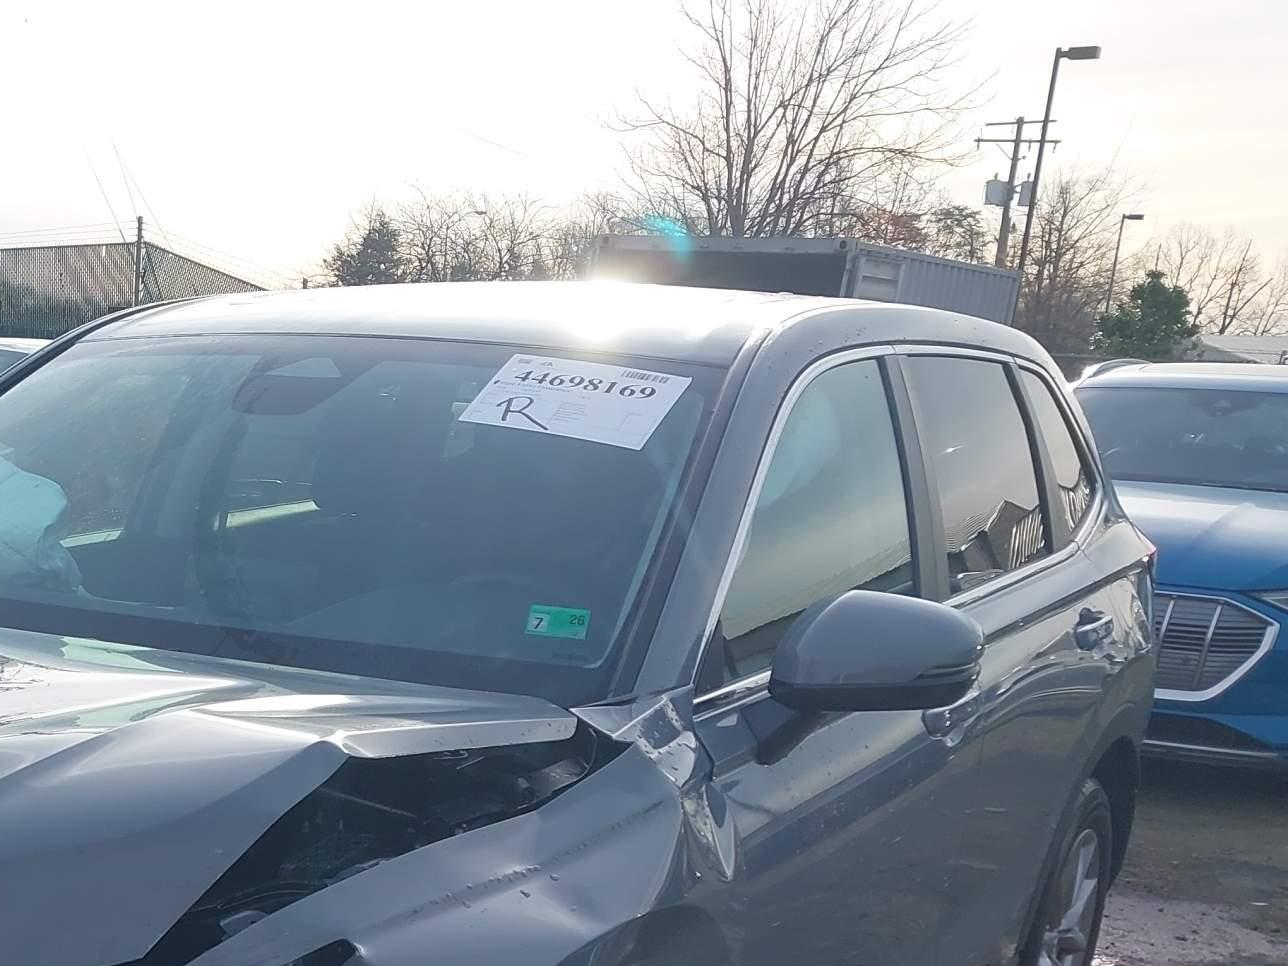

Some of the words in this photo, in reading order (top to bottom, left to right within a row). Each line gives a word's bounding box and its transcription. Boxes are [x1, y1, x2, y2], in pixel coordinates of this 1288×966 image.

[514, 370, 657, 399] 44698169
[496, 395, 549, 431] R
[533, 617, 544, 630] 7
